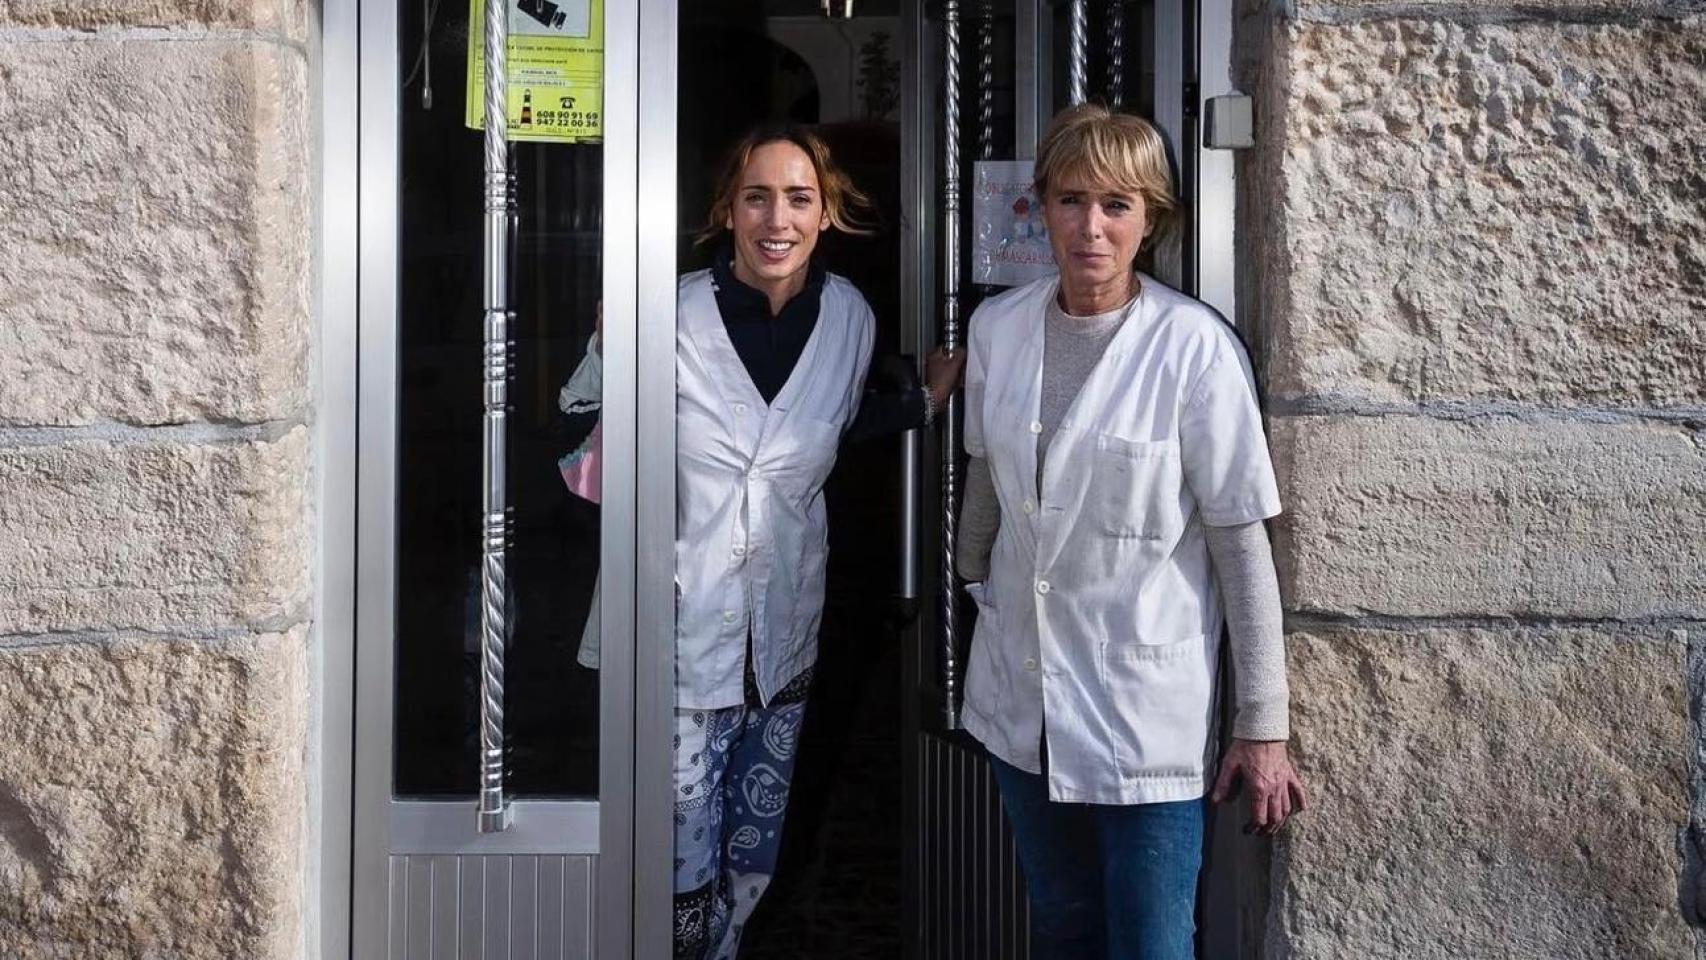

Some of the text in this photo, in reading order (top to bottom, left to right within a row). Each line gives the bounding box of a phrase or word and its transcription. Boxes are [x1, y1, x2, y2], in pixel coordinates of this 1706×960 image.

[536, 110, 555, 119] 608
[557, 111, 570, 119] 90
[585, 112, 599, 120] 69
[536, 118, 555, 126] 947
[557, 119, 569, 127] 22
[571, 119, 584, 127] 00
